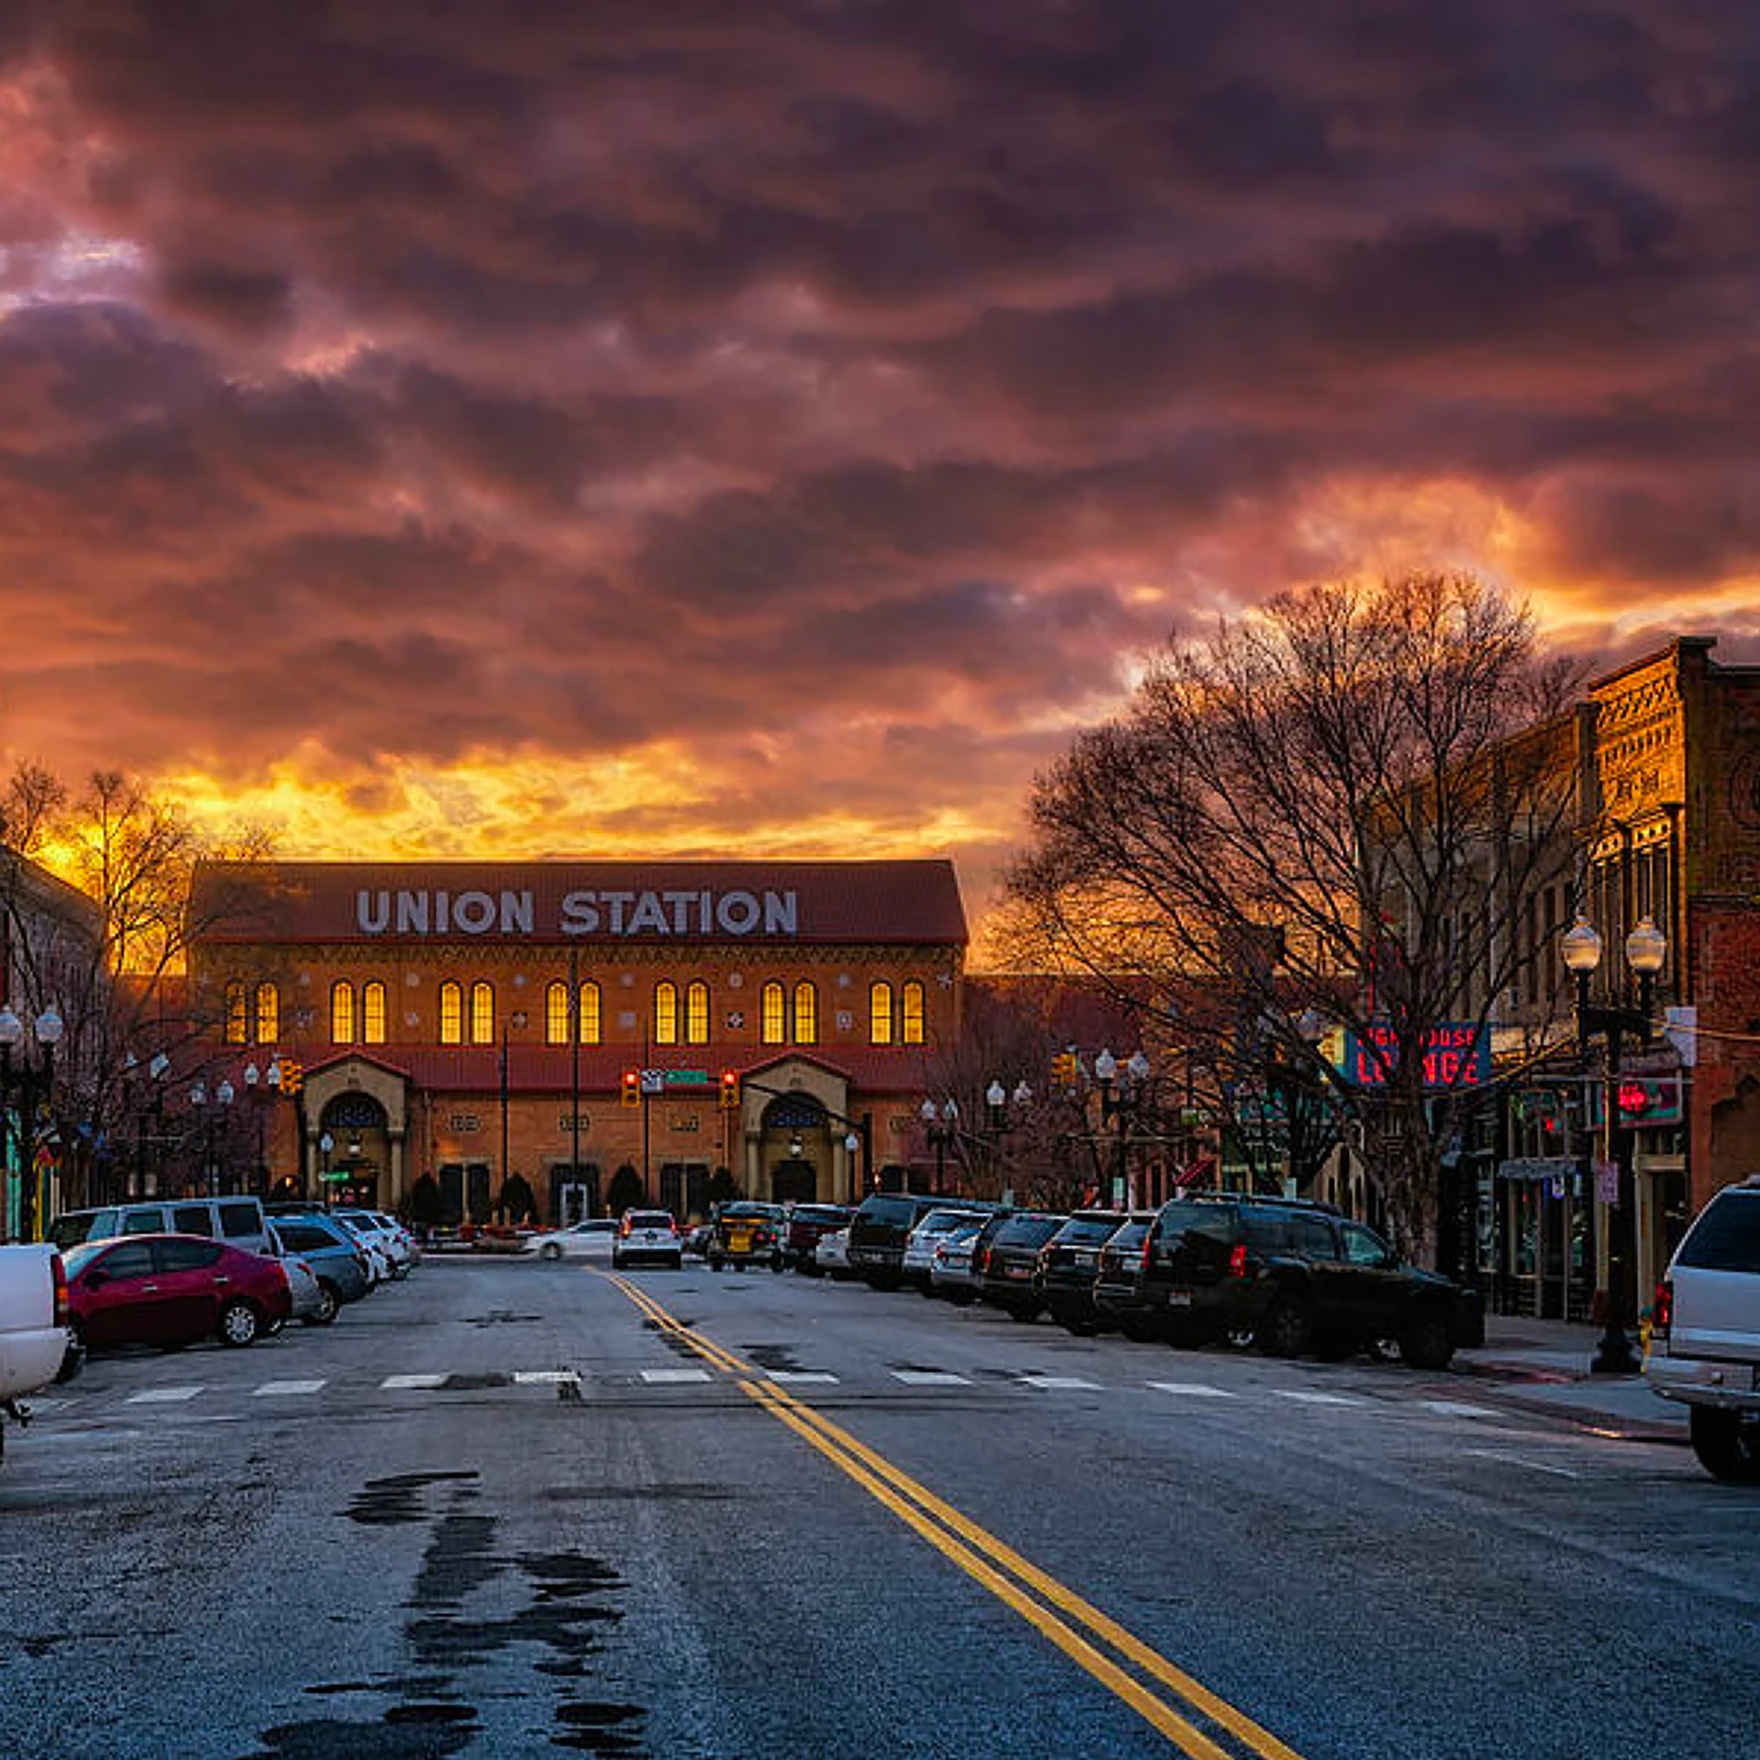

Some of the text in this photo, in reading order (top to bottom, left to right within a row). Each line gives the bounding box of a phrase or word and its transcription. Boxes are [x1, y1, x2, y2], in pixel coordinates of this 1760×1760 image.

[356, 890, 798, 935] UNION STATION
[1357, 1051, 1479, 1084] LONGE
